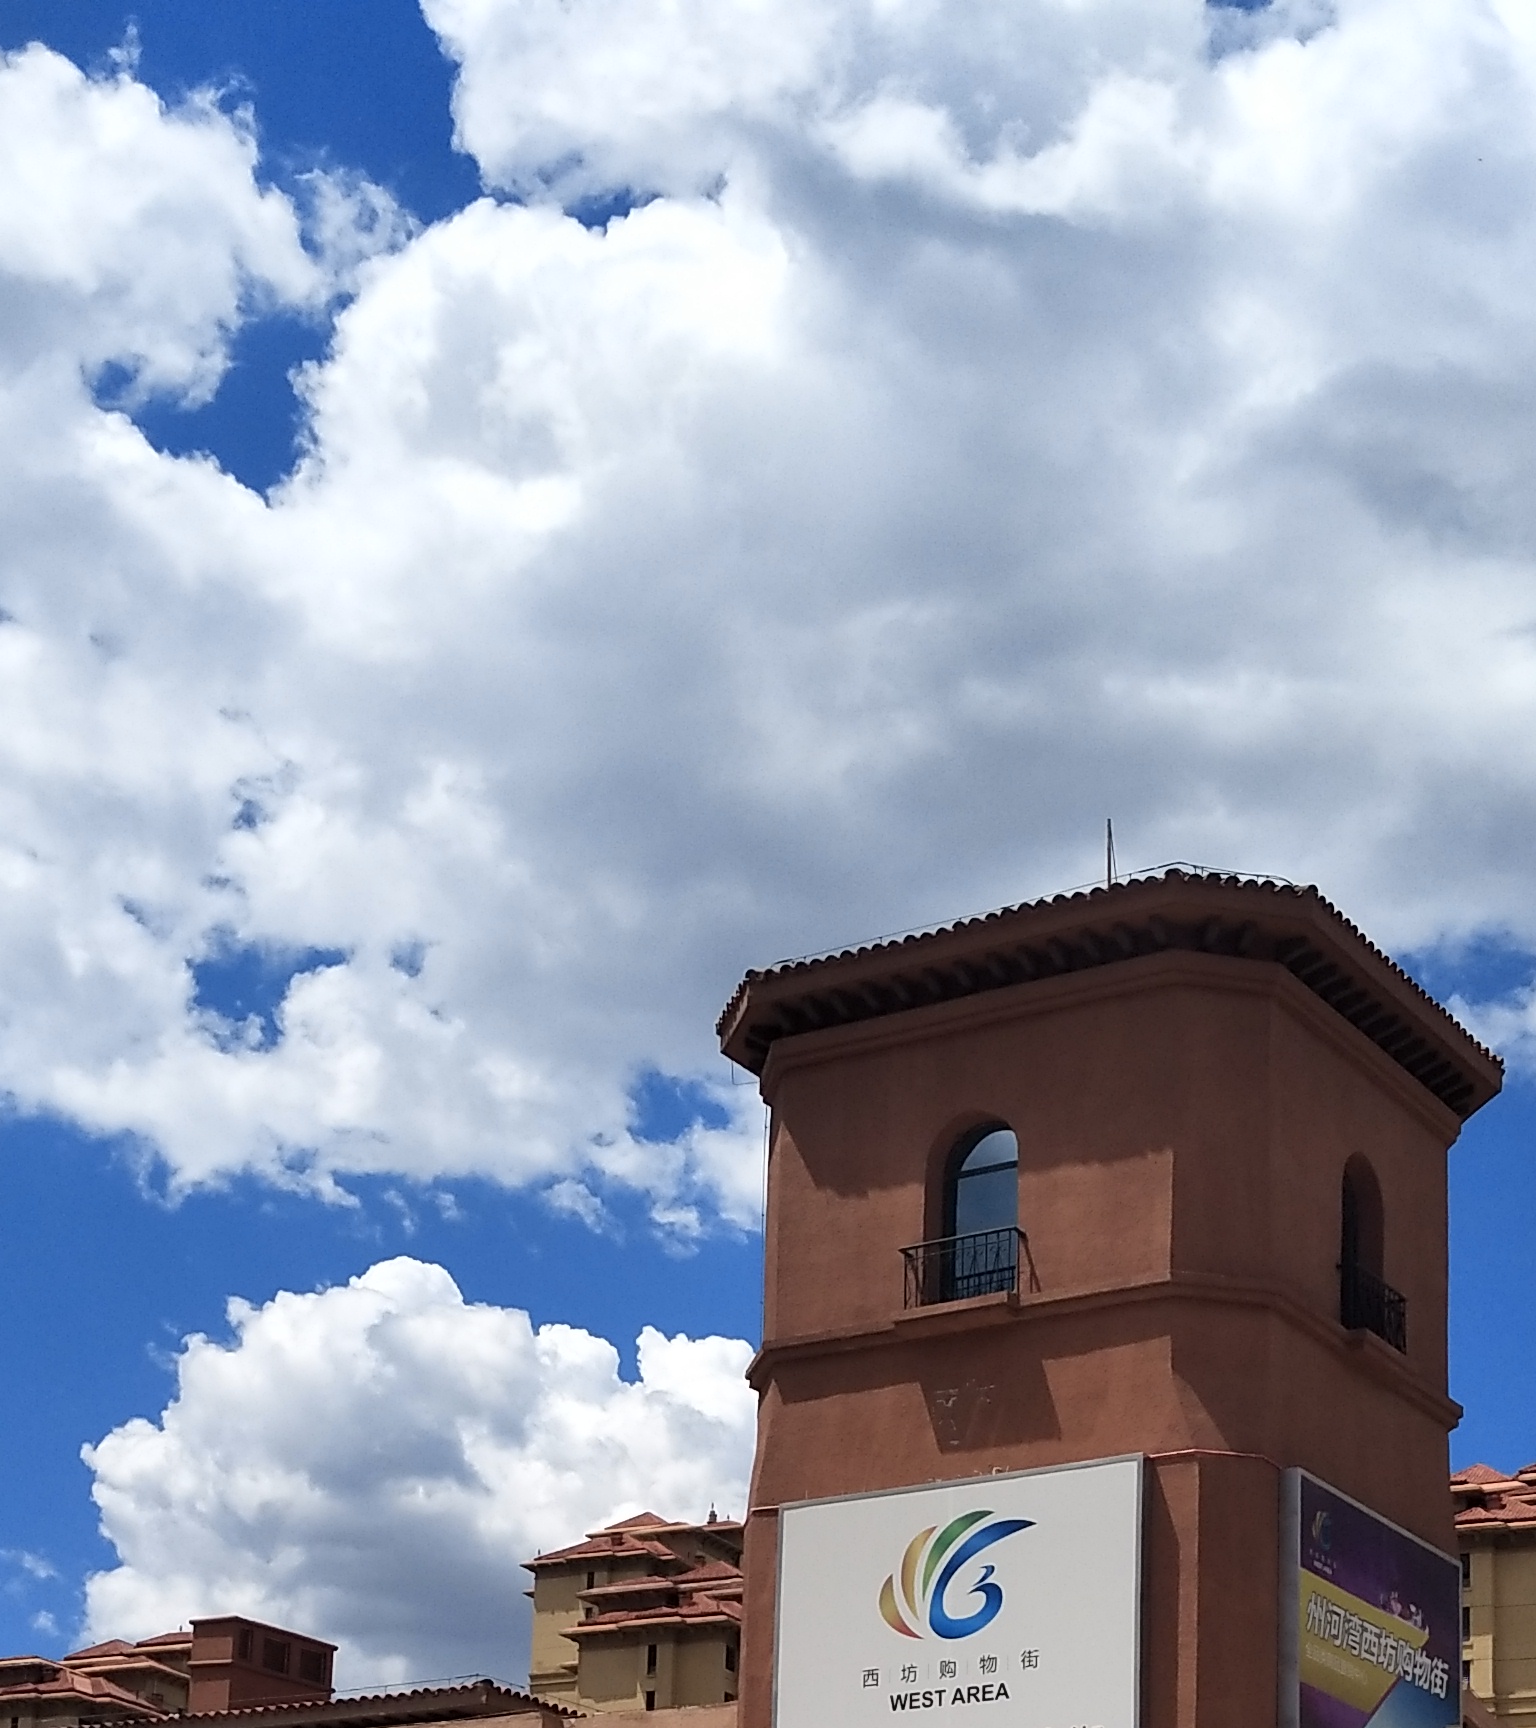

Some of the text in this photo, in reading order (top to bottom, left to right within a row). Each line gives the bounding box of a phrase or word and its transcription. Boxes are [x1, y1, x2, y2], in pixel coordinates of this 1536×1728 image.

[1306, 1591, 1451, 1700] 州河湾西坊购物街
[862, 1649, 1040, 1689] 西坊购物街
[890, 1683, 1010, 1712] WEST AREA
